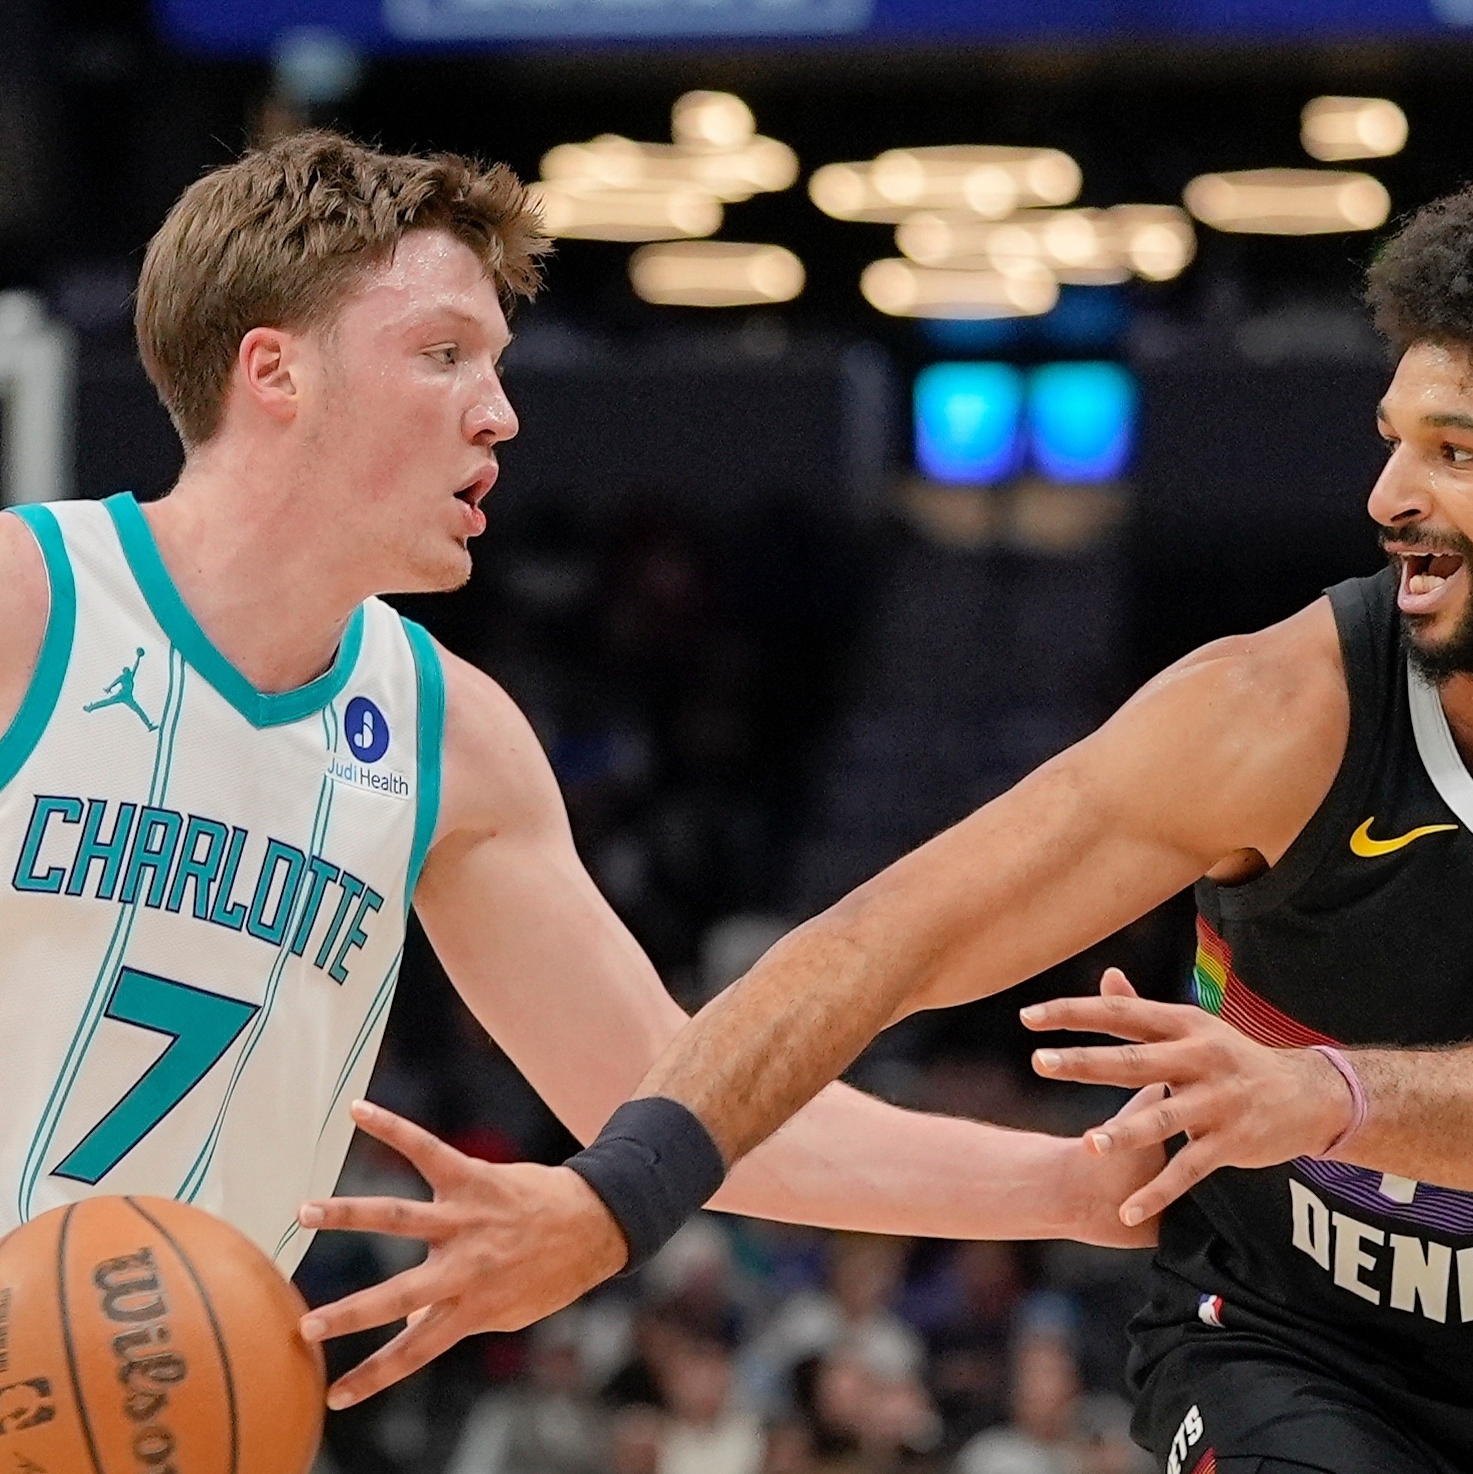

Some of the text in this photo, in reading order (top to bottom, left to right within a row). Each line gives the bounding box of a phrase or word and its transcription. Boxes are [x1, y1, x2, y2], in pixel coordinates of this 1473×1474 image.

[327, 757, 409, 796] Judi Health
[13, 795, 384, 986] CHARLOTTE
[50, 966, 262, 1186] 7
